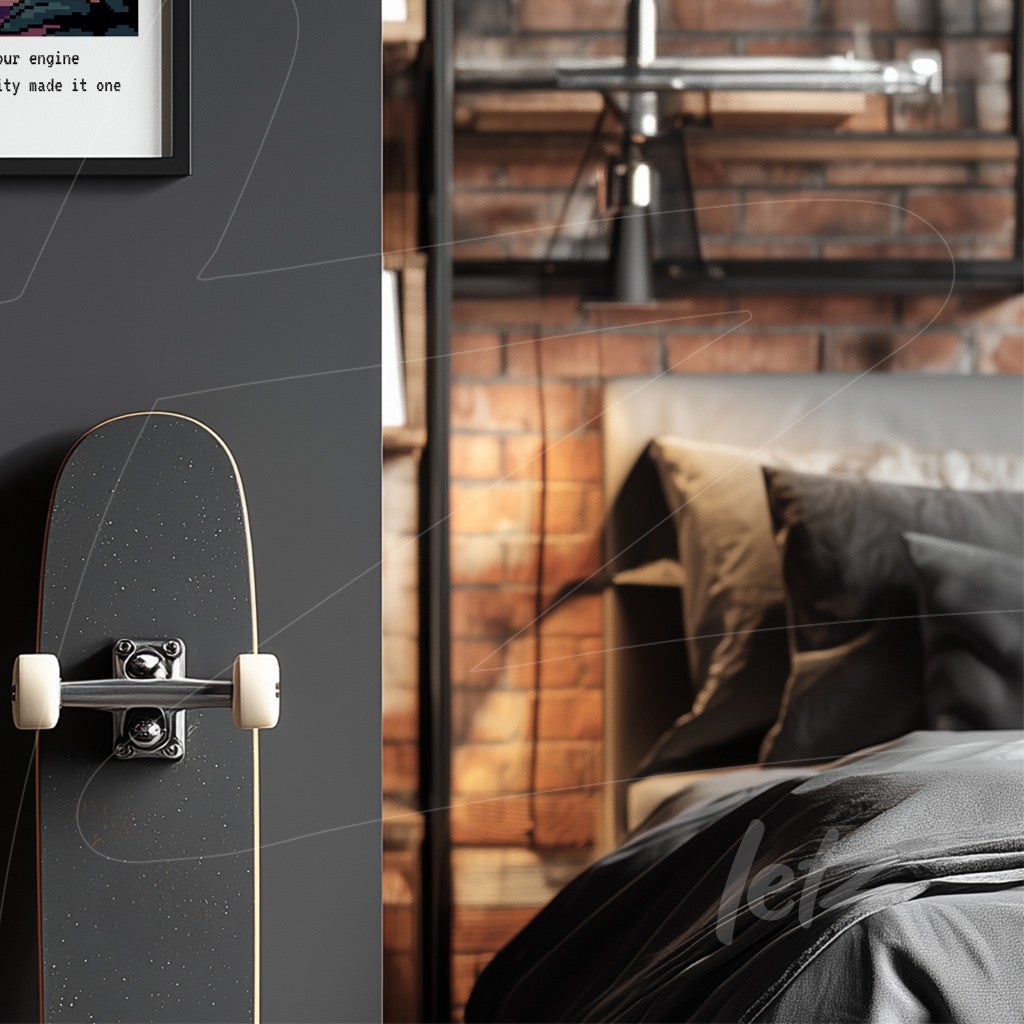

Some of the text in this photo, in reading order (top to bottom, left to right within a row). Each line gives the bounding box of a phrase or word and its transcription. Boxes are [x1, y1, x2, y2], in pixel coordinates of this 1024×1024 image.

[28, 50, 80, 68] engine
[29, 78, 63, 92] made
[72, 78, 87, 92] it
[96, 81, 121, 92] one
